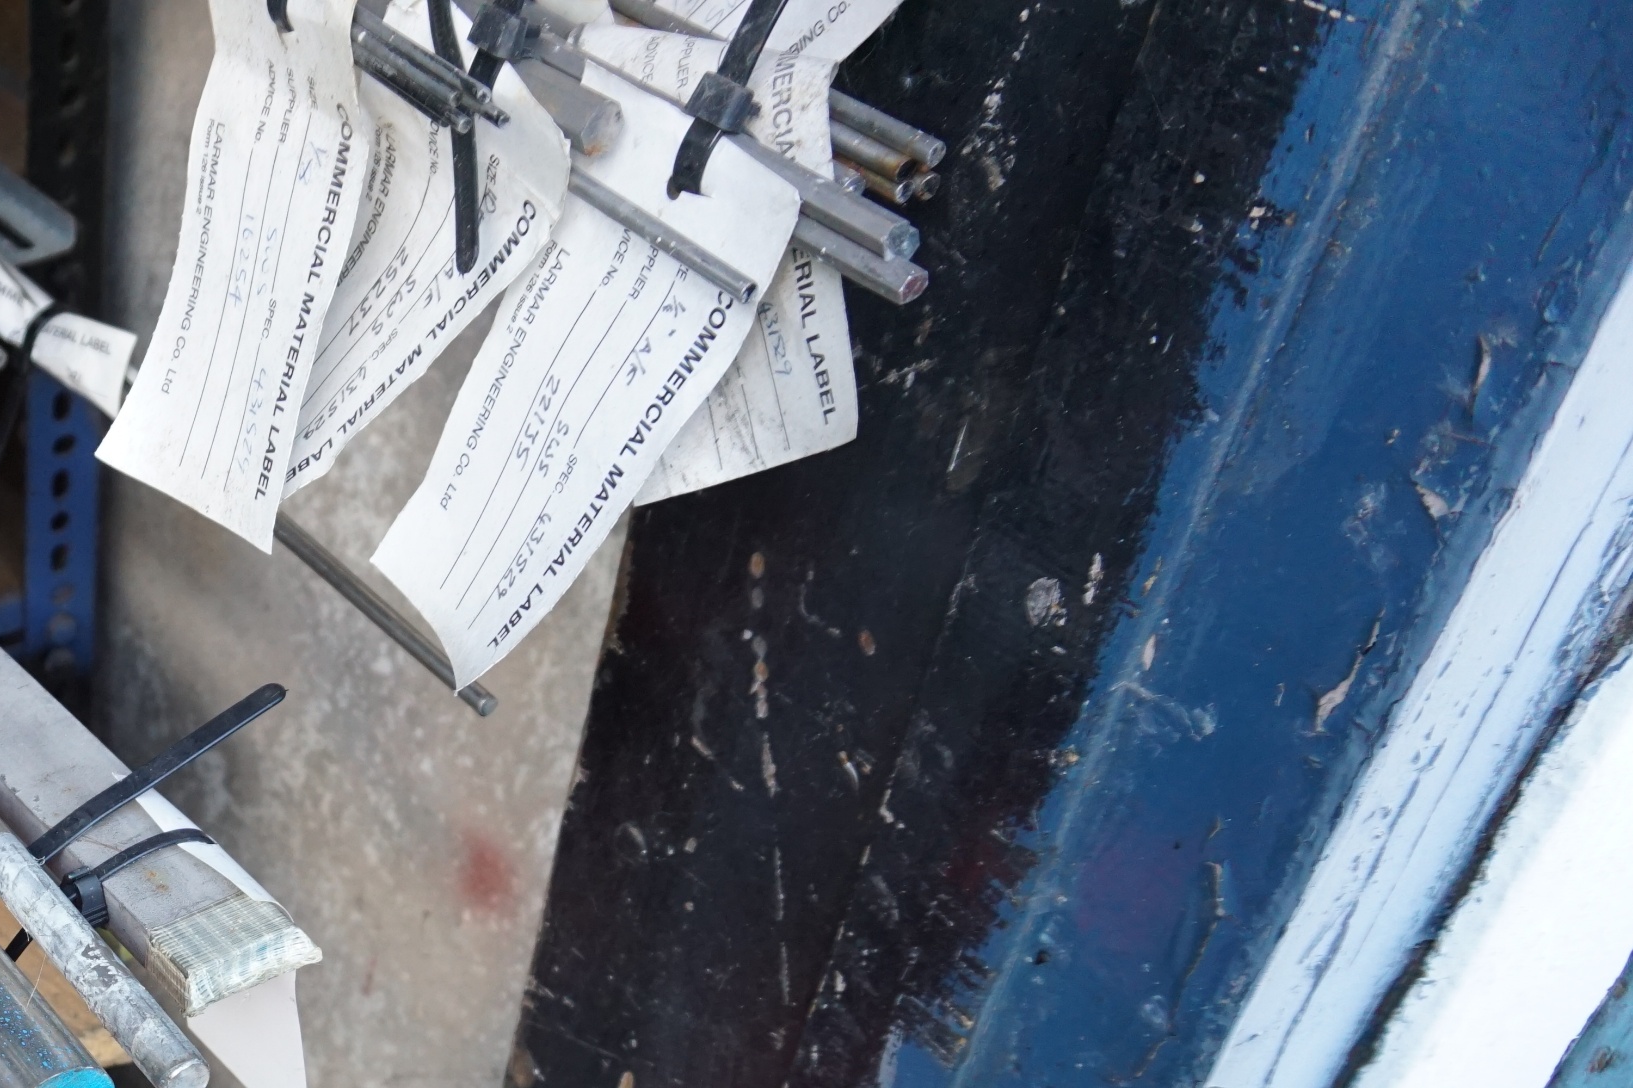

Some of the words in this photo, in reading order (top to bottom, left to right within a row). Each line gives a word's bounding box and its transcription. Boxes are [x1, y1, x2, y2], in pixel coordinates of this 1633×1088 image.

[826, 1, 852, 24] Co.
[675, 36, 695, 90] PPLIER
[261, 59, 276, 118] ADVICE
[277, 67, 297, 145] SUPPLIER
[772, 50, 800, 163] MERCIA
[201, 117, 216, 149] Form
[253, 119, 269, 145] No.
[428, 120, 441, 158] DVICE
[199, 152, 210, 176] 126
[206, 122, 226, 202] LARMAR
[376, 133, 397, 199] LARMAR
[483, 152, 501, 185] SIZE
[195, 177, 206, 209] issue
[307, 102, 353, 285] COMMERCIAL
[177, 204, 213, 331] ENGINEERING
[336, 201, 386, 287] ENGINEERI
[537, 238, 559, 270] Form
[612, 227, 632, 265] VICE
[425, 198, 537, 341] COMMERCIAL
[522, 247, 572, 325] LARMAR
[525, 271, 541, 294] 126
[598, 264, 619, 288] No.
[628, 244, 660, 302] PPLIER
[261, 298, 277, 341] SPEC.
[507, 324, 514, 334] 2
[513, 293, 529, 324] issue
[171, 335, 186, 362] Co.
[273, 291, 315, 417] MATERIAL
[370, 326, 399, 361] SPEC.
[791, 246, 817, 330] ERIAL
[805, 333, 837, 427] LABEL
[160, 367, 177, 396] Ltd
[337, 343, 424, 436] MATERIAL
[466, 326, 528, 451] ENGINEERING
[619, 289, 734, 459] COMMERCIAL
[254, 428, 280, 500] LABEL
[285, 436, 334, 483] LABE
[451, 453, 471, 477] Co.
[554, 453, 579, 495] SPEC.
[439, 483, 458, 512] Ltd
[542, 463, 625, 579] MATERIAL
[486, 582, 544, 650] LABEL
